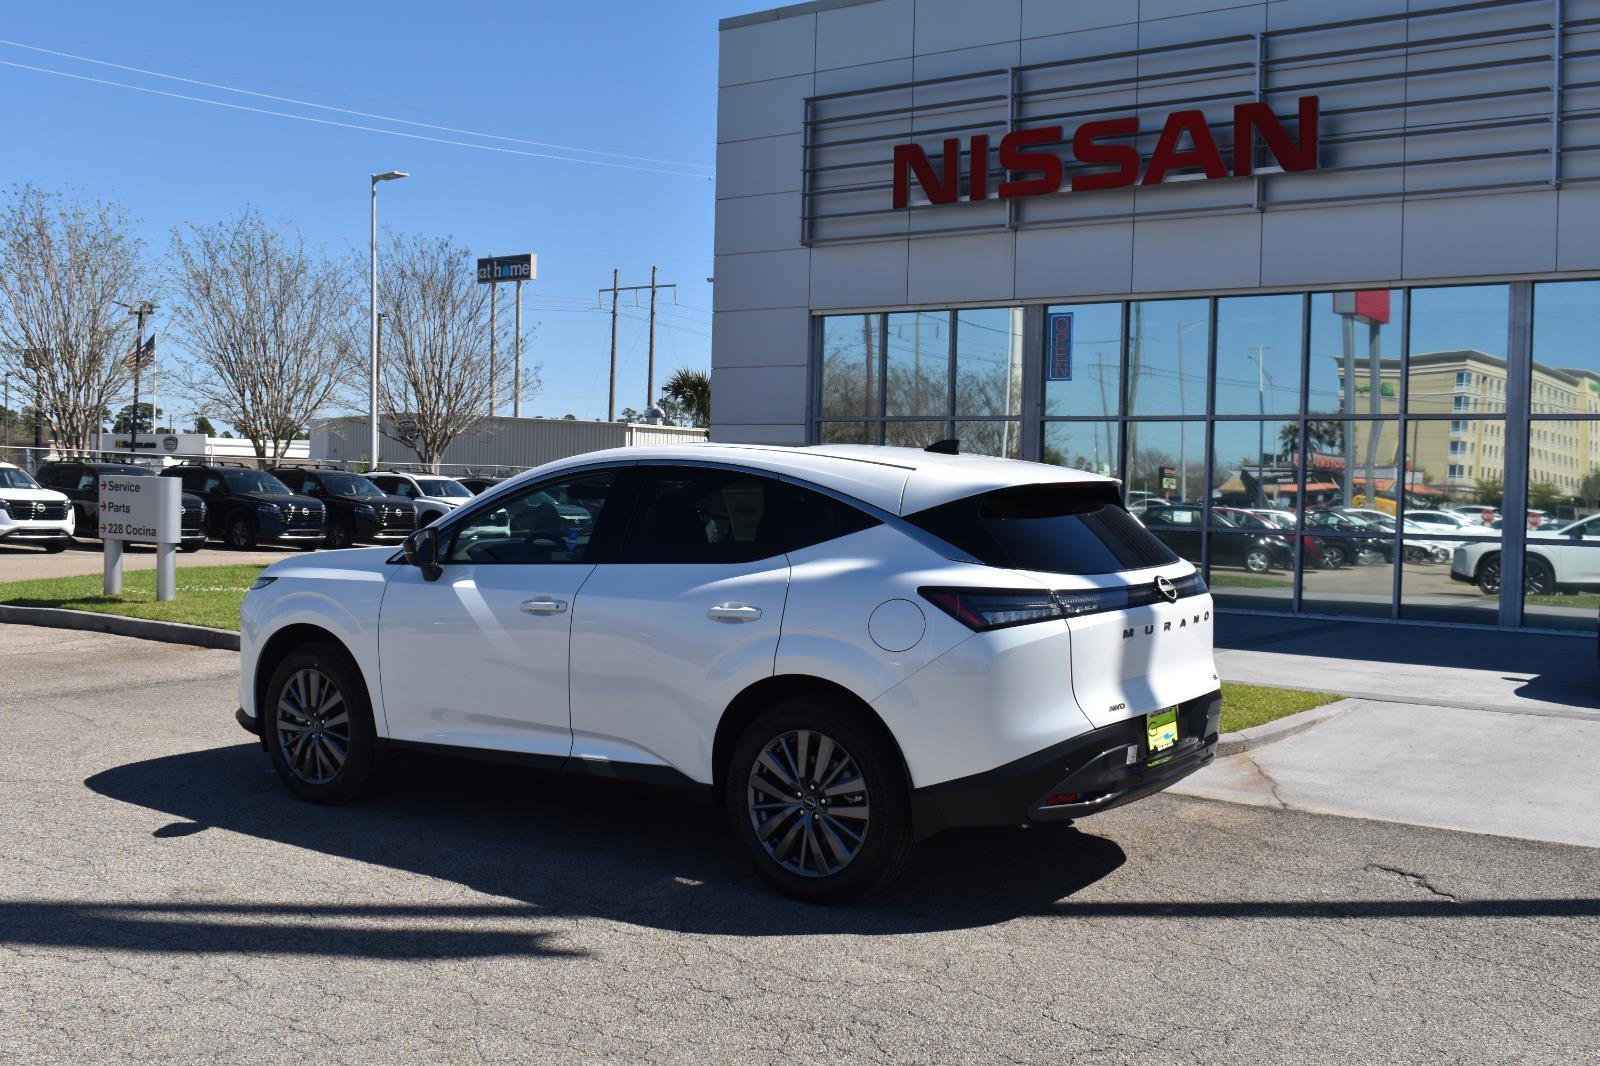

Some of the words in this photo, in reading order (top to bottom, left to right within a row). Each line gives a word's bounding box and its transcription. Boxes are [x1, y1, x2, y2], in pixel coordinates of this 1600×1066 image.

[893, 96, 1320, 209] NISSAN
[479, 263, 490, 279] at
[494, 260, 530, 277] home
[108, 481, 141, 493] Service
[108, 502, 131, 513] Parts
[108, 523, 123, 535] 228
[125, 524, 157, 537] Cocina
[1122, 611, 1209, 639] MURANO
[1109, 703, 1126, 712] AWD
